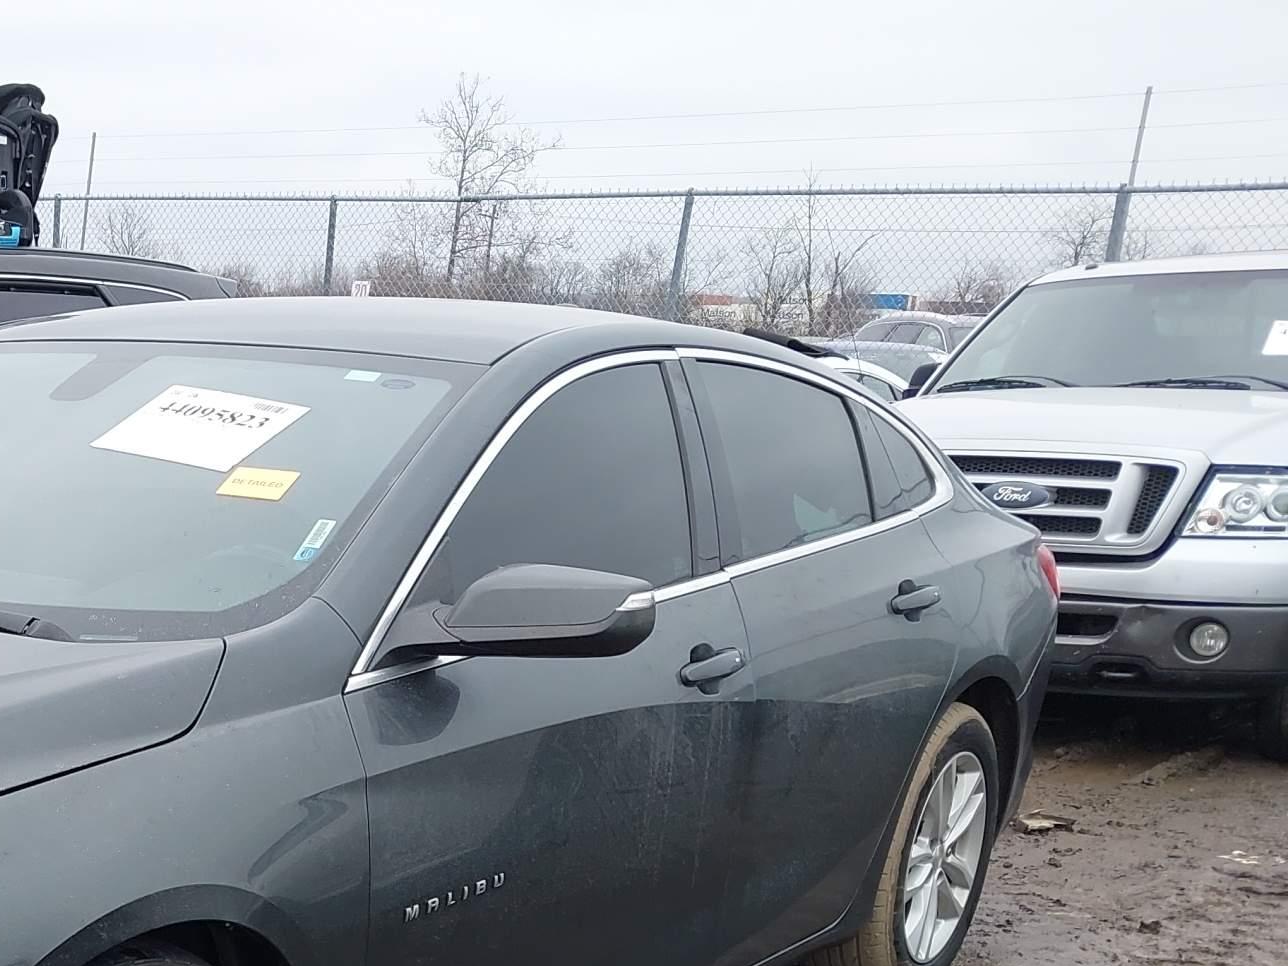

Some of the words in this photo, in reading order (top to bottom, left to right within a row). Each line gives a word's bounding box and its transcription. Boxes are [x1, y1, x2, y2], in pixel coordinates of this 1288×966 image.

[159, 402, 270, 428] 44095823
[993, 486, 1032, 502] Ford
[404, 872, 505, 922] MALIBU
